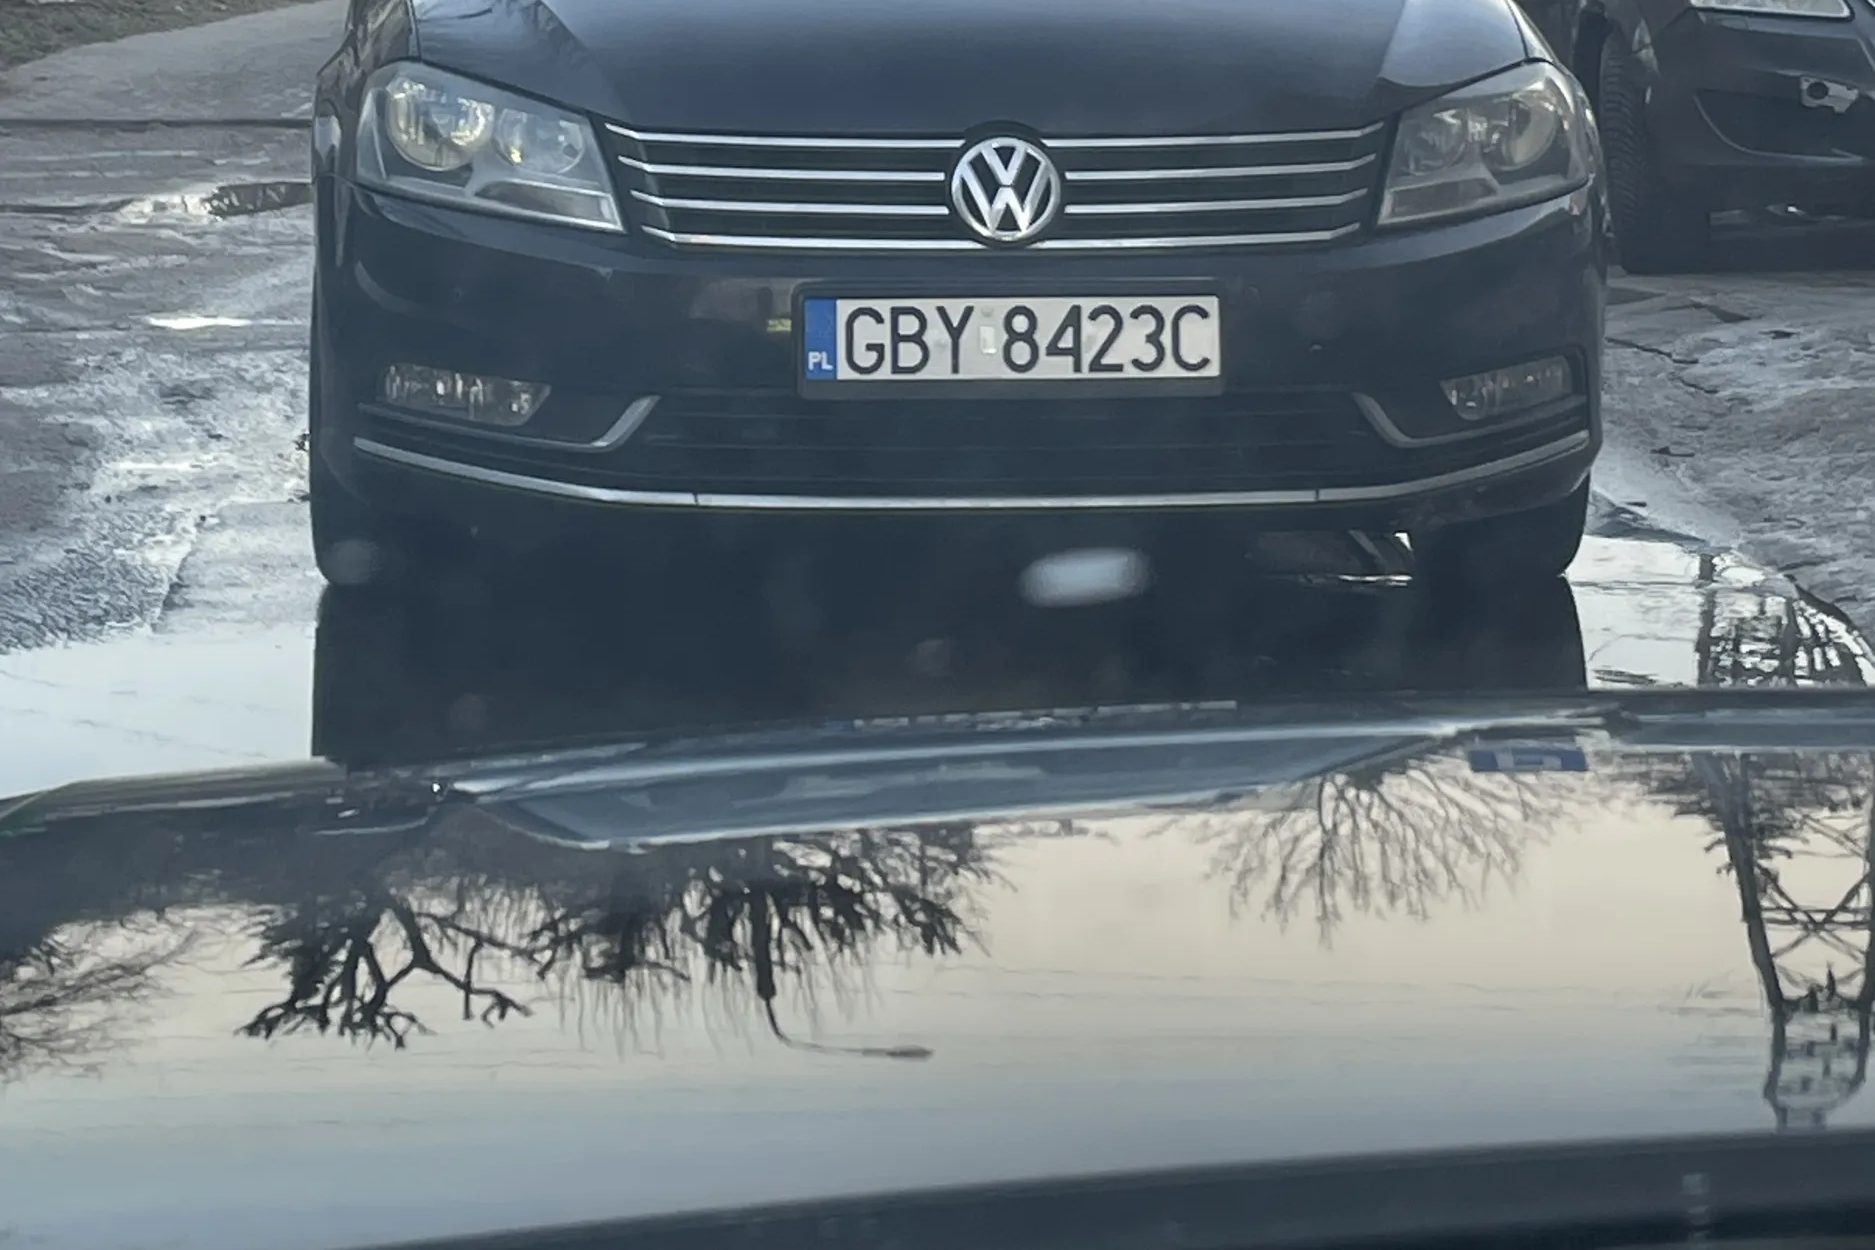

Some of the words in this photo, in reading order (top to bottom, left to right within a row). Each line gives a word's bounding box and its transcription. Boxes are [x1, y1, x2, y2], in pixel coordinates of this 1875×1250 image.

[808, 351, 833, 370] PL
[845, 306, 974, 375] GBY
[1002, 304, 1211, 374] 8423C
